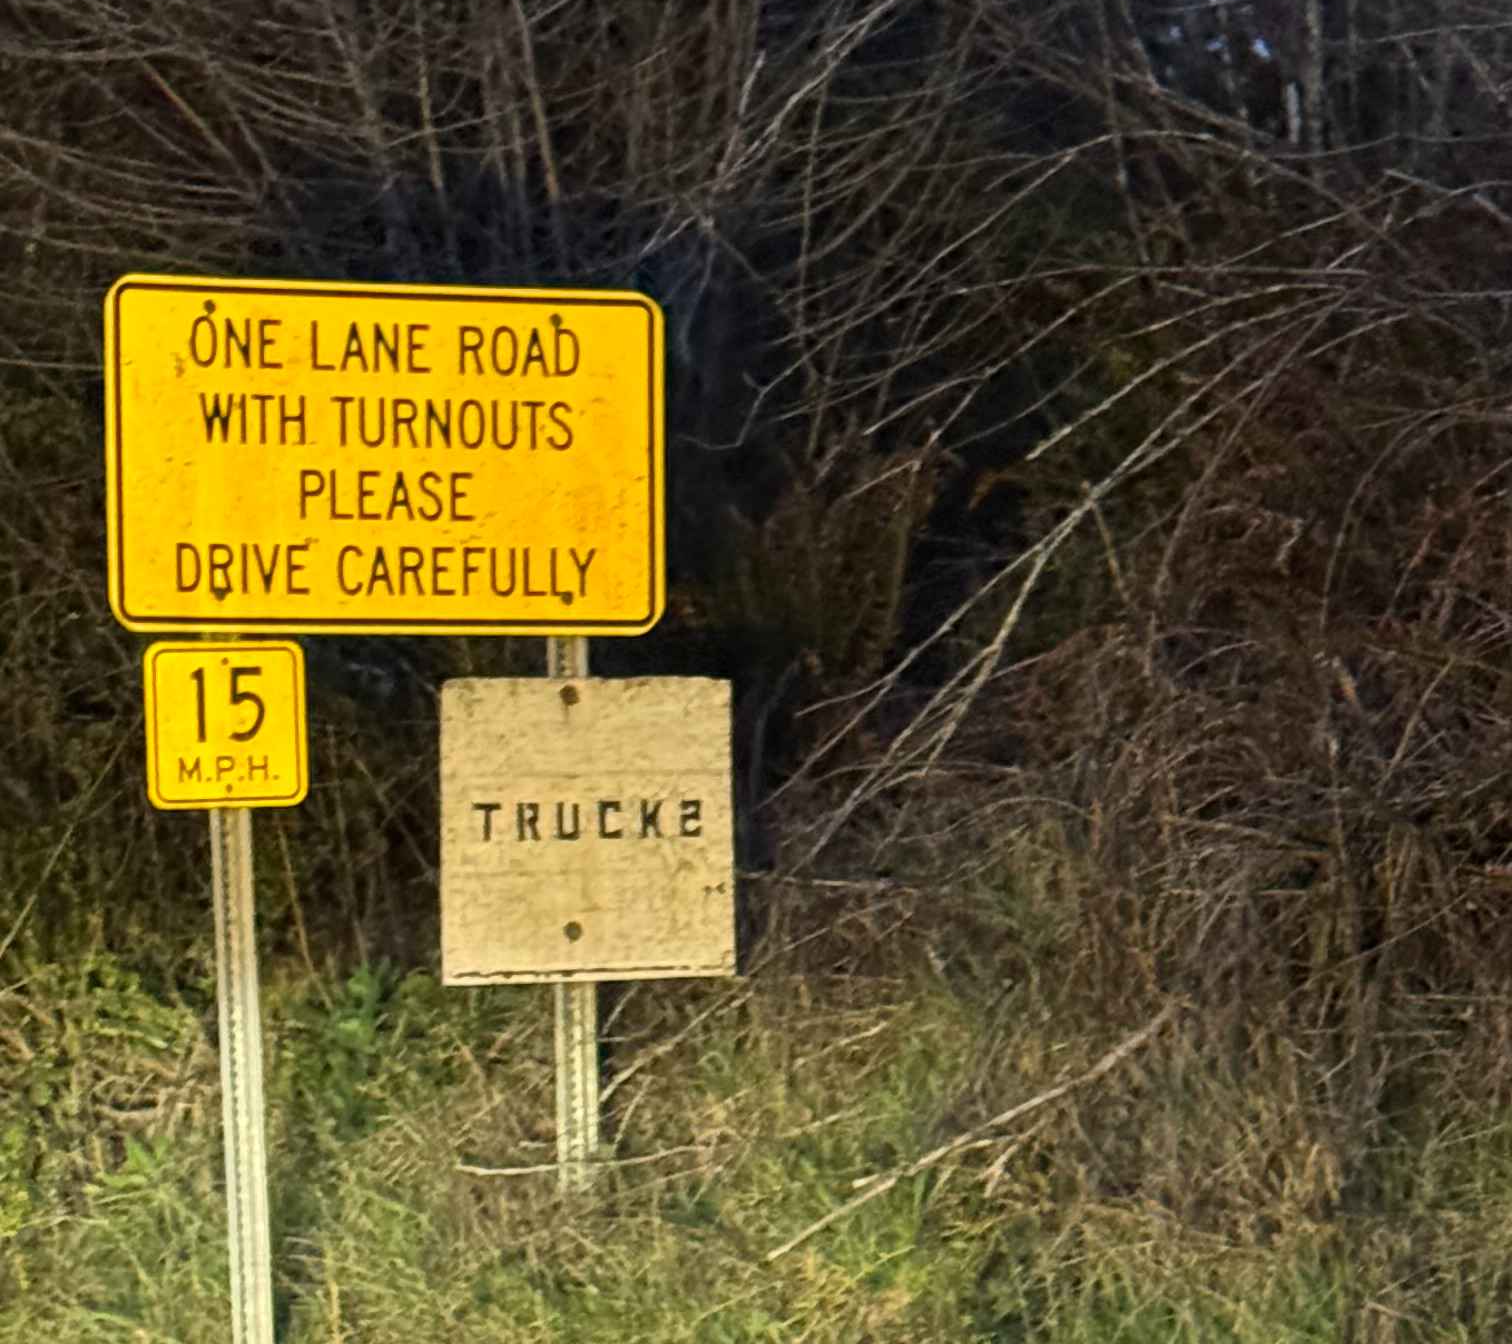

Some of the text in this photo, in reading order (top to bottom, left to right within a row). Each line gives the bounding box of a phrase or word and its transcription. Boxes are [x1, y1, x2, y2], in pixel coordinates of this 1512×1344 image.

[190, 316, 580, 377] ONE LANE ROAD
[200, 393, 573, 451] WITH TURNOUTS
[300, 470, 474, 521] PLEASE
[176, 543, 596, 597] DRIVE CAREFULLY
[190, 666, 265, 743] 15
[178, 755, 280, 783] M.P.H.
